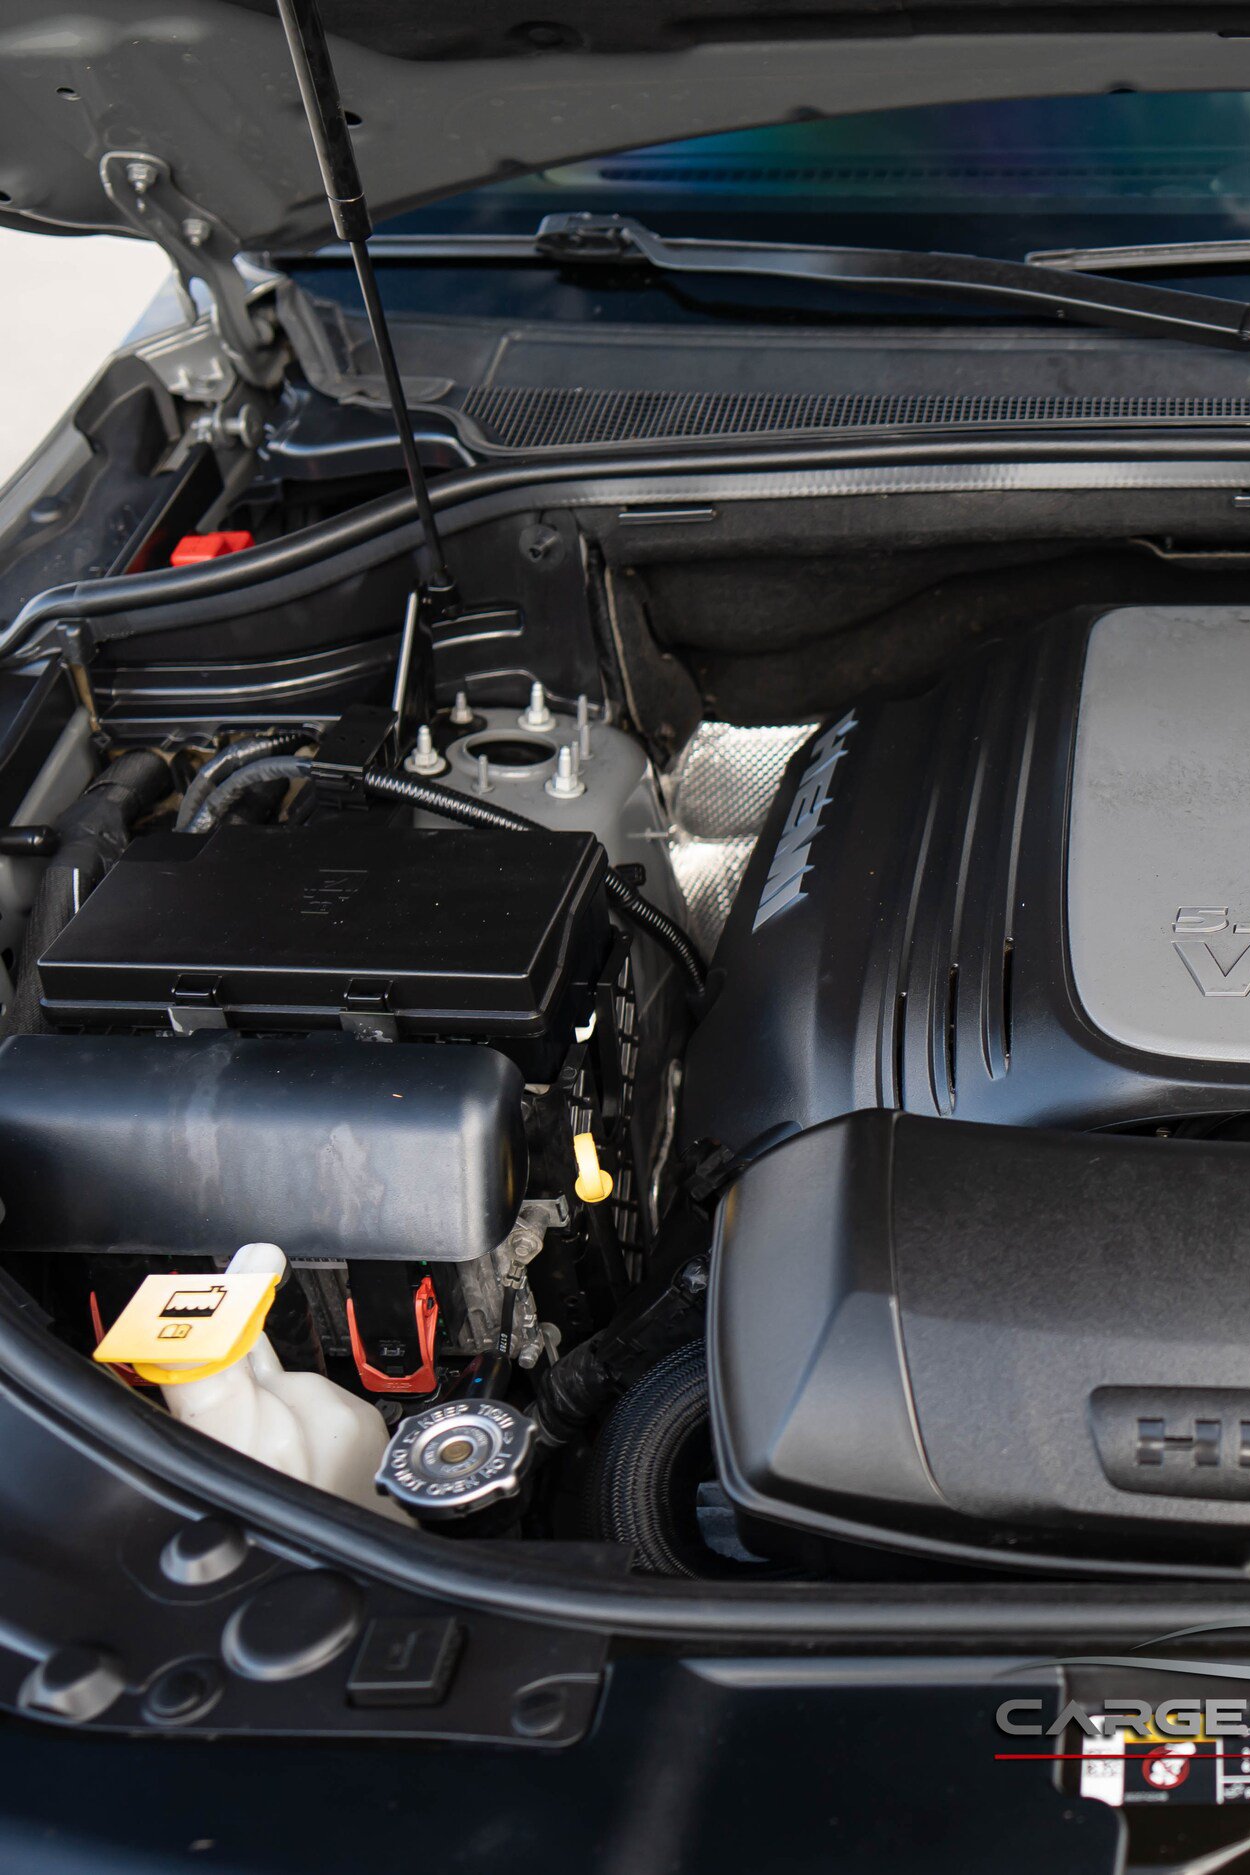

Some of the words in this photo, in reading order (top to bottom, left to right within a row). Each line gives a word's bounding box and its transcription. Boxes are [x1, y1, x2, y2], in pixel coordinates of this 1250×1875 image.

[752, 708, 858, 934] HEMI
[417, 1404, 469, 1429] KEEP
[390, 1449, 408, 1469] DO
[479, 1453, 513, 1479] HOT
[394, 1469, 427, 1492] NOT
[426, 1475, 480, 1496] OPEN
